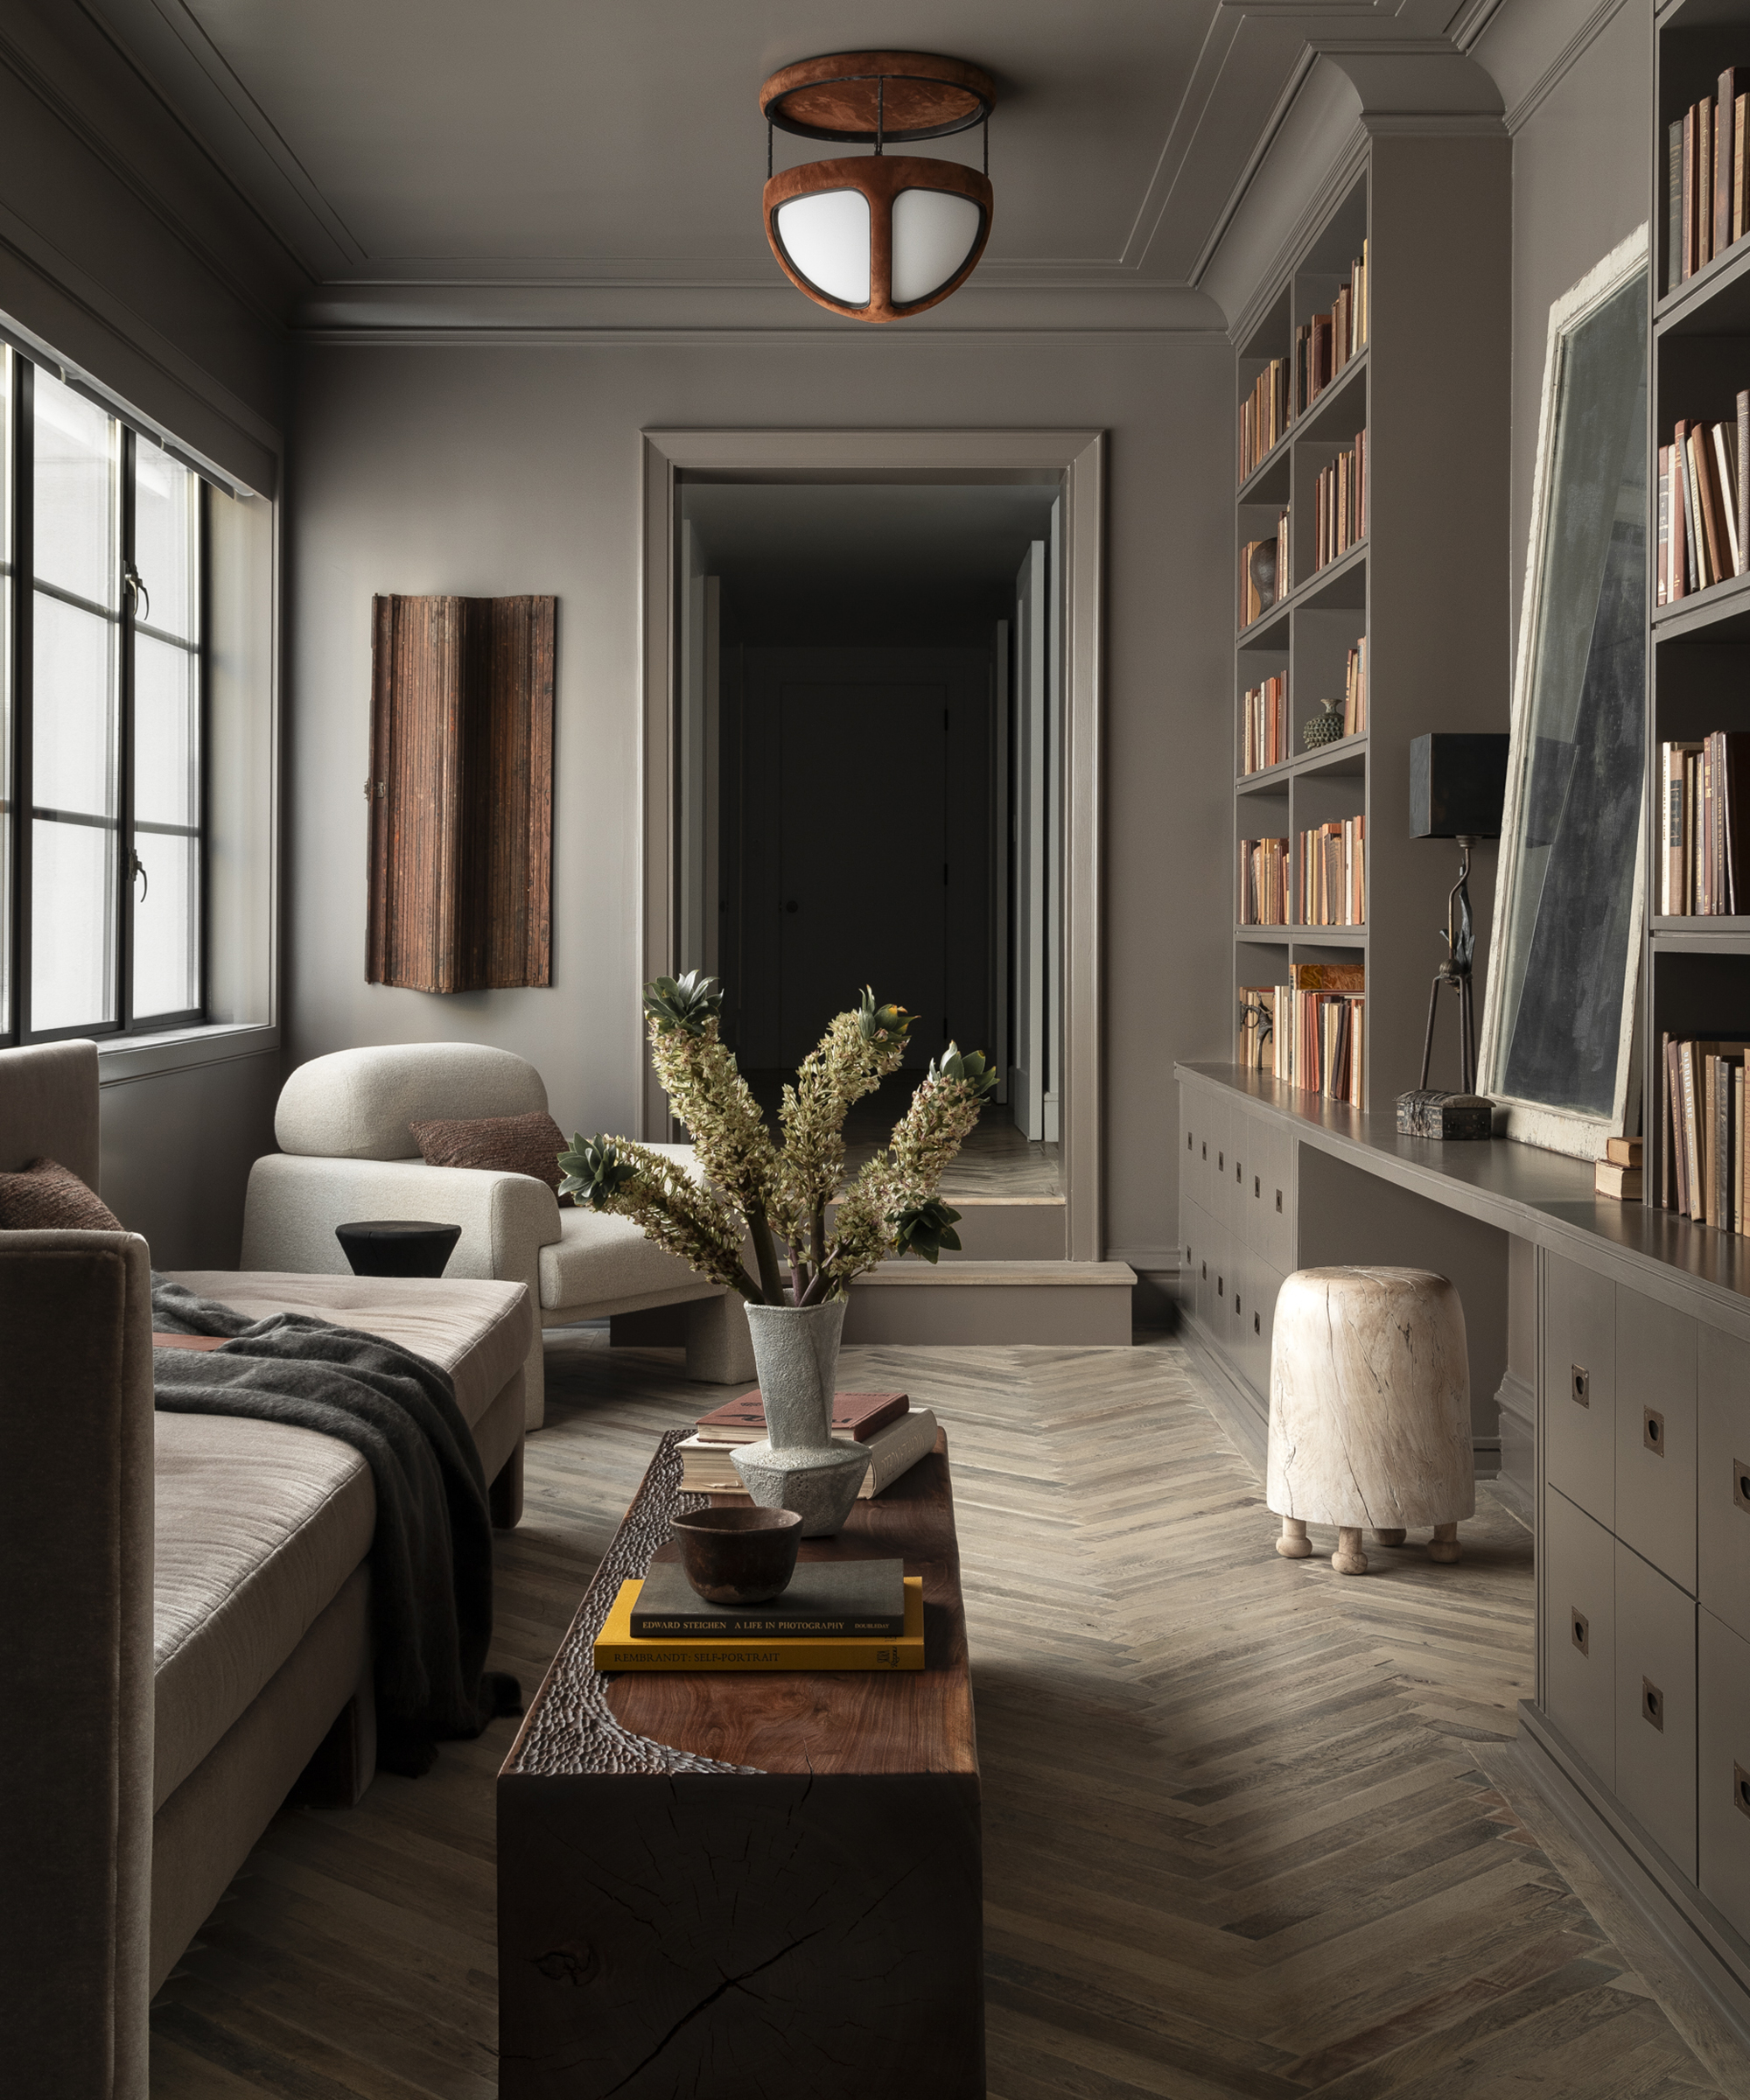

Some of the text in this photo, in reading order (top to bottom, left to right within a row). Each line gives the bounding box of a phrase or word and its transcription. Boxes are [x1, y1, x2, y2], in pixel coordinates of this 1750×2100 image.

[1683, 1051, 1691, 1093] BARBARA
[613, 1653, 780, 1662] REMBRANDT: SELF-PORTRAIT
